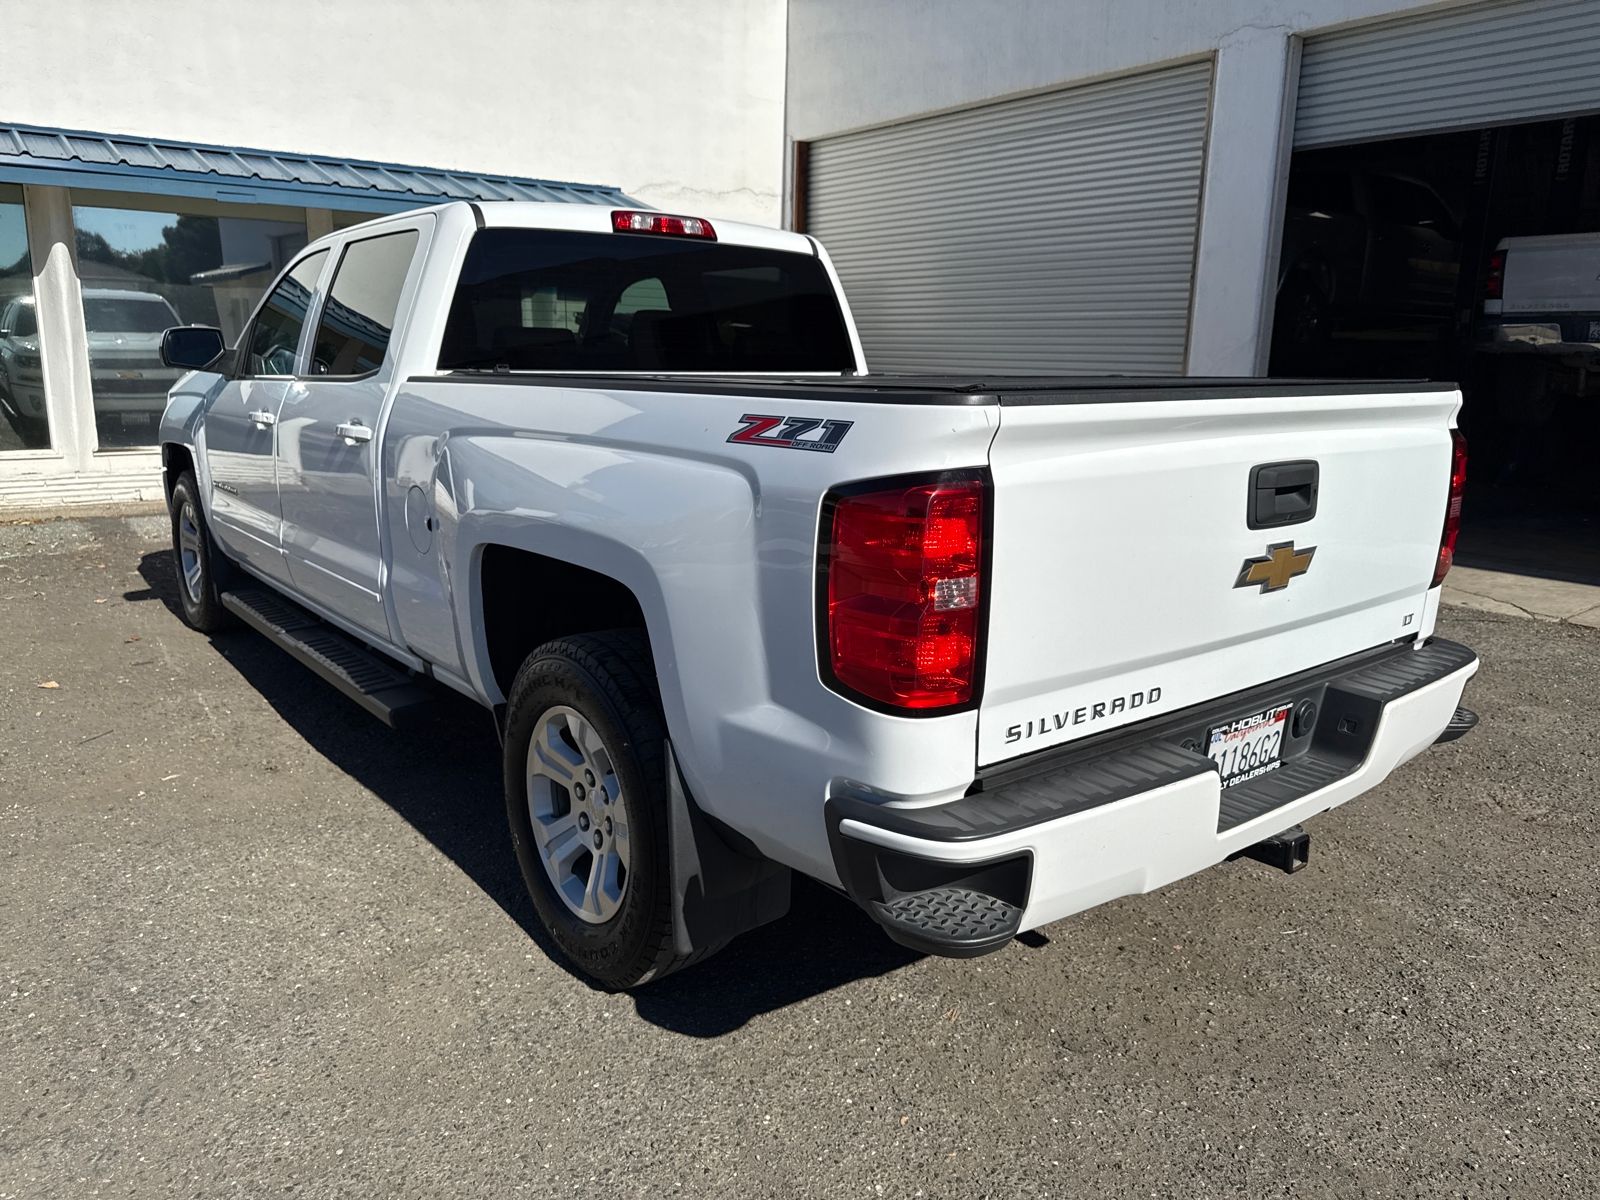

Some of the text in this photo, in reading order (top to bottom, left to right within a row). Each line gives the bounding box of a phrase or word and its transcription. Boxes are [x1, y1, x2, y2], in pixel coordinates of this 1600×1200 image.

[725, 413, 855, 452] Z71
[791, 441, 836, 451] OFF ROAD
[1402, 613, 1415, 627] LT
[1004, 686, 1162, 744] SILVERADO
[1230, 707, 1277, 733] HOBLIT
[1210, 730, 1280, 779] 1186G2
[1229, 760, 1282, 788] DEALERSHIPS
